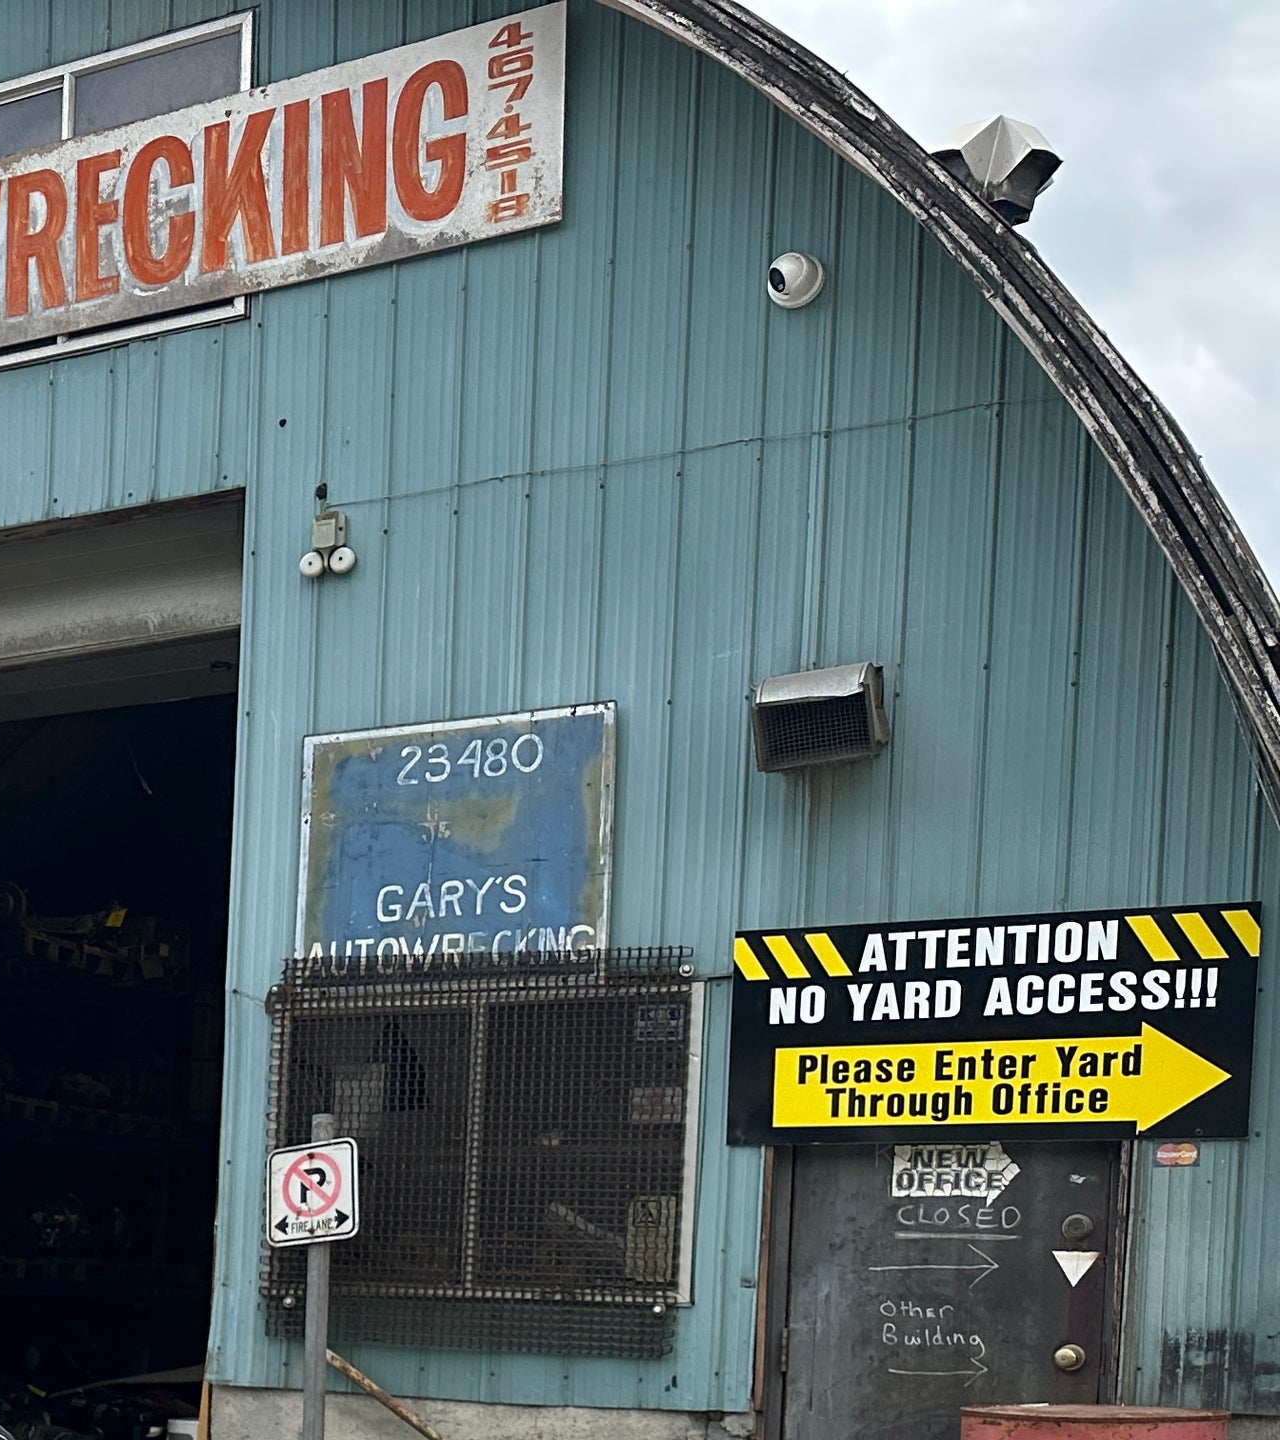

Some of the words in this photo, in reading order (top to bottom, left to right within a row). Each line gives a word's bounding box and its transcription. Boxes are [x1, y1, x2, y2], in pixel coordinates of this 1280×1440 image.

[396, 733, 545, 786] 23480
[376, 874, 528, 923] GARY'S
[858, 919, 1120, 973] ATTENTION
[768, 984, 826, 1025] NO
[847, 979, 963, 1022] YARD
[982, 967, 1219, 1017] ACCESS!!!
[797, 1053, 915, 1085] Please
[934, 1050, 1037, 1081] Enter
[1055, 1043, 1142, 1077] Yard
[825, 1086, 974, 1122] Through
[991, 1083, 1109, 1115] Office
[912, 1149, 987, 1169] NEW
[896, 1169, 1004, 1191] OFFICE
[291, 1219, 308, 1234] FIRE
[896, 1203, 1022, 1230] CLOSED
[880, 1300, 955, 1320] Other
[882, 1323, 986, 1359] Building
